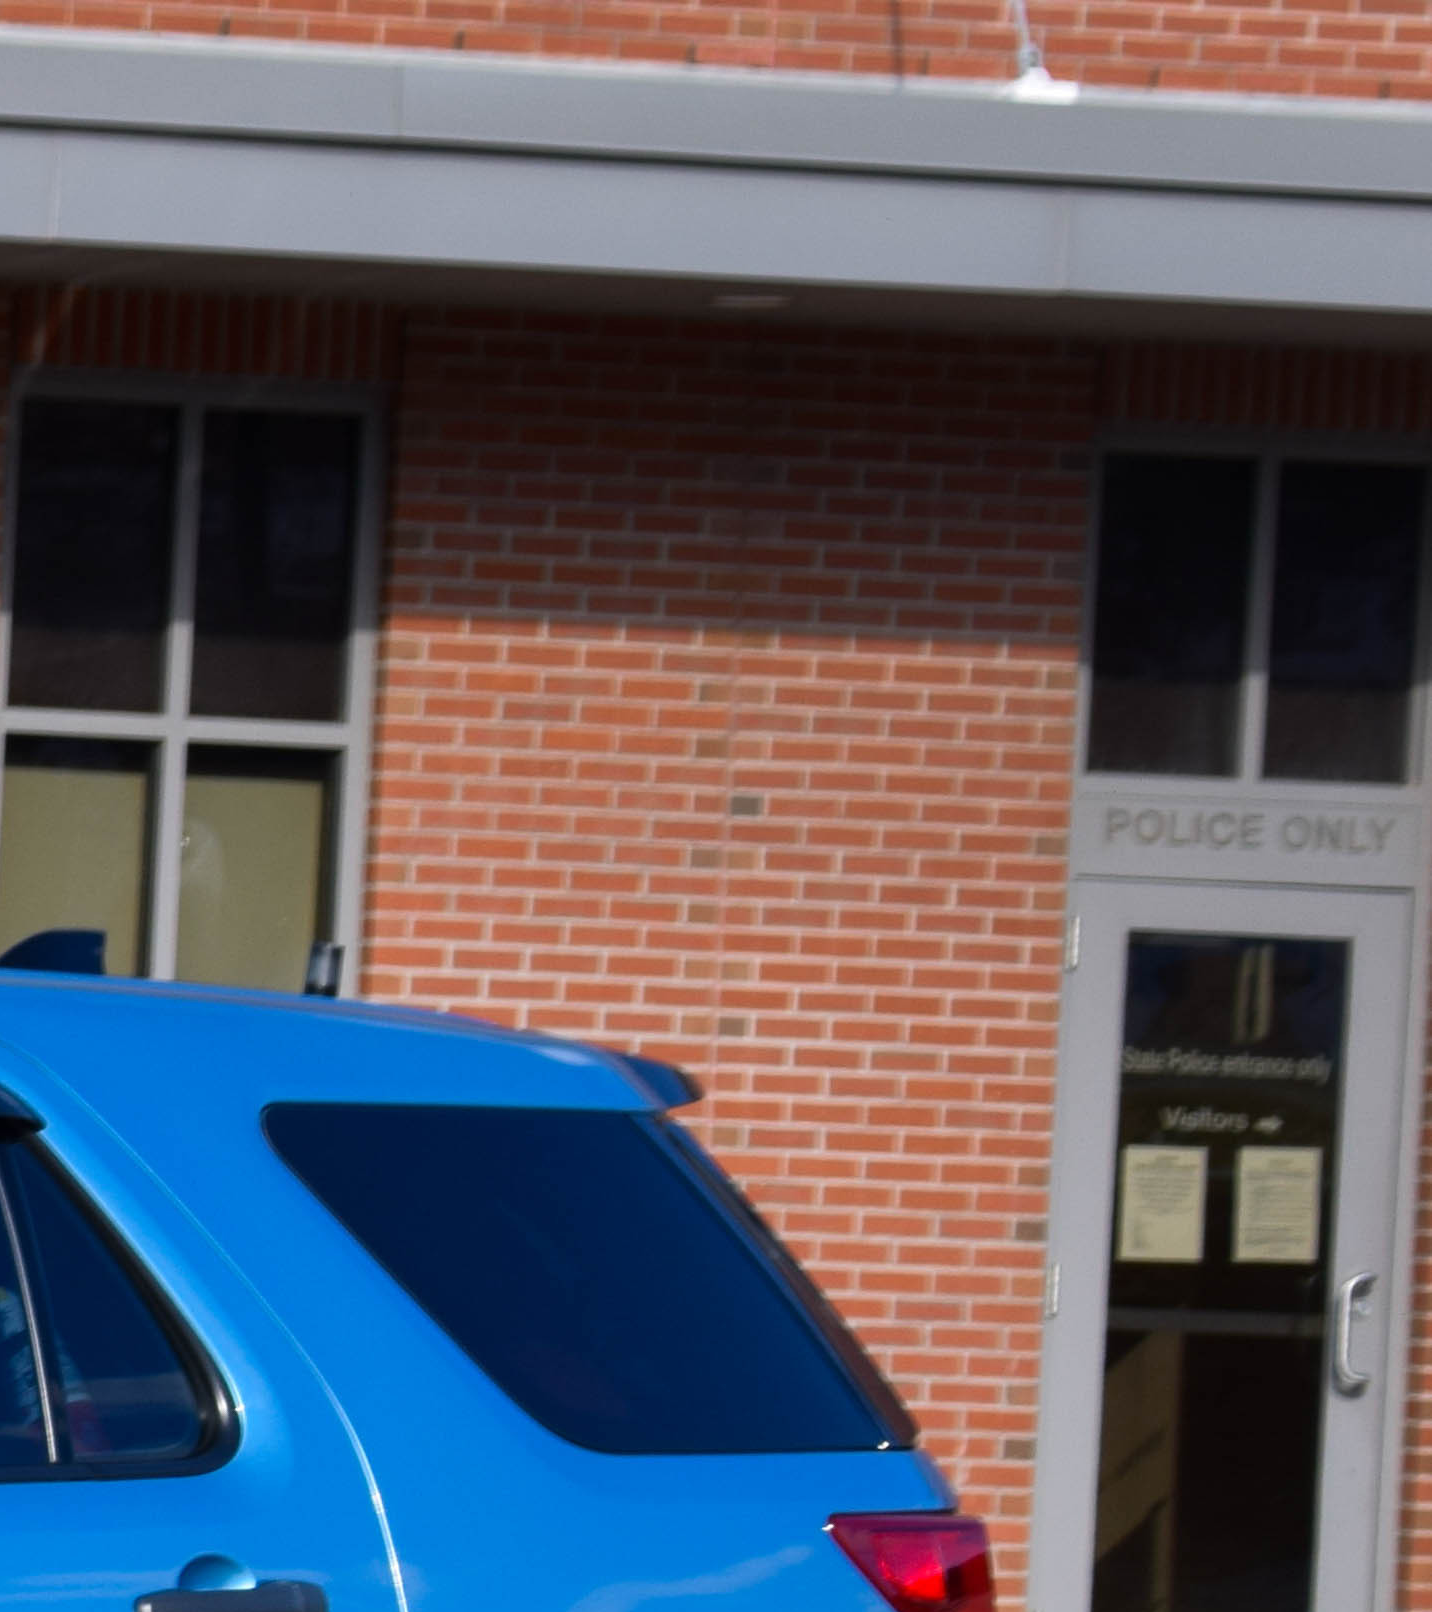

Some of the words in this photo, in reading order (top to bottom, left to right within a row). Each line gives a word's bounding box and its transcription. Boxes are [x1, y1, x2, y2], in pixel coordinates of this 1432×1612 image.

[1105, 807, 1265, 848] POLICE
[1282, 814, 1397, 853] ONLY
[1160, 1105, 1249, 1132] Visitors
